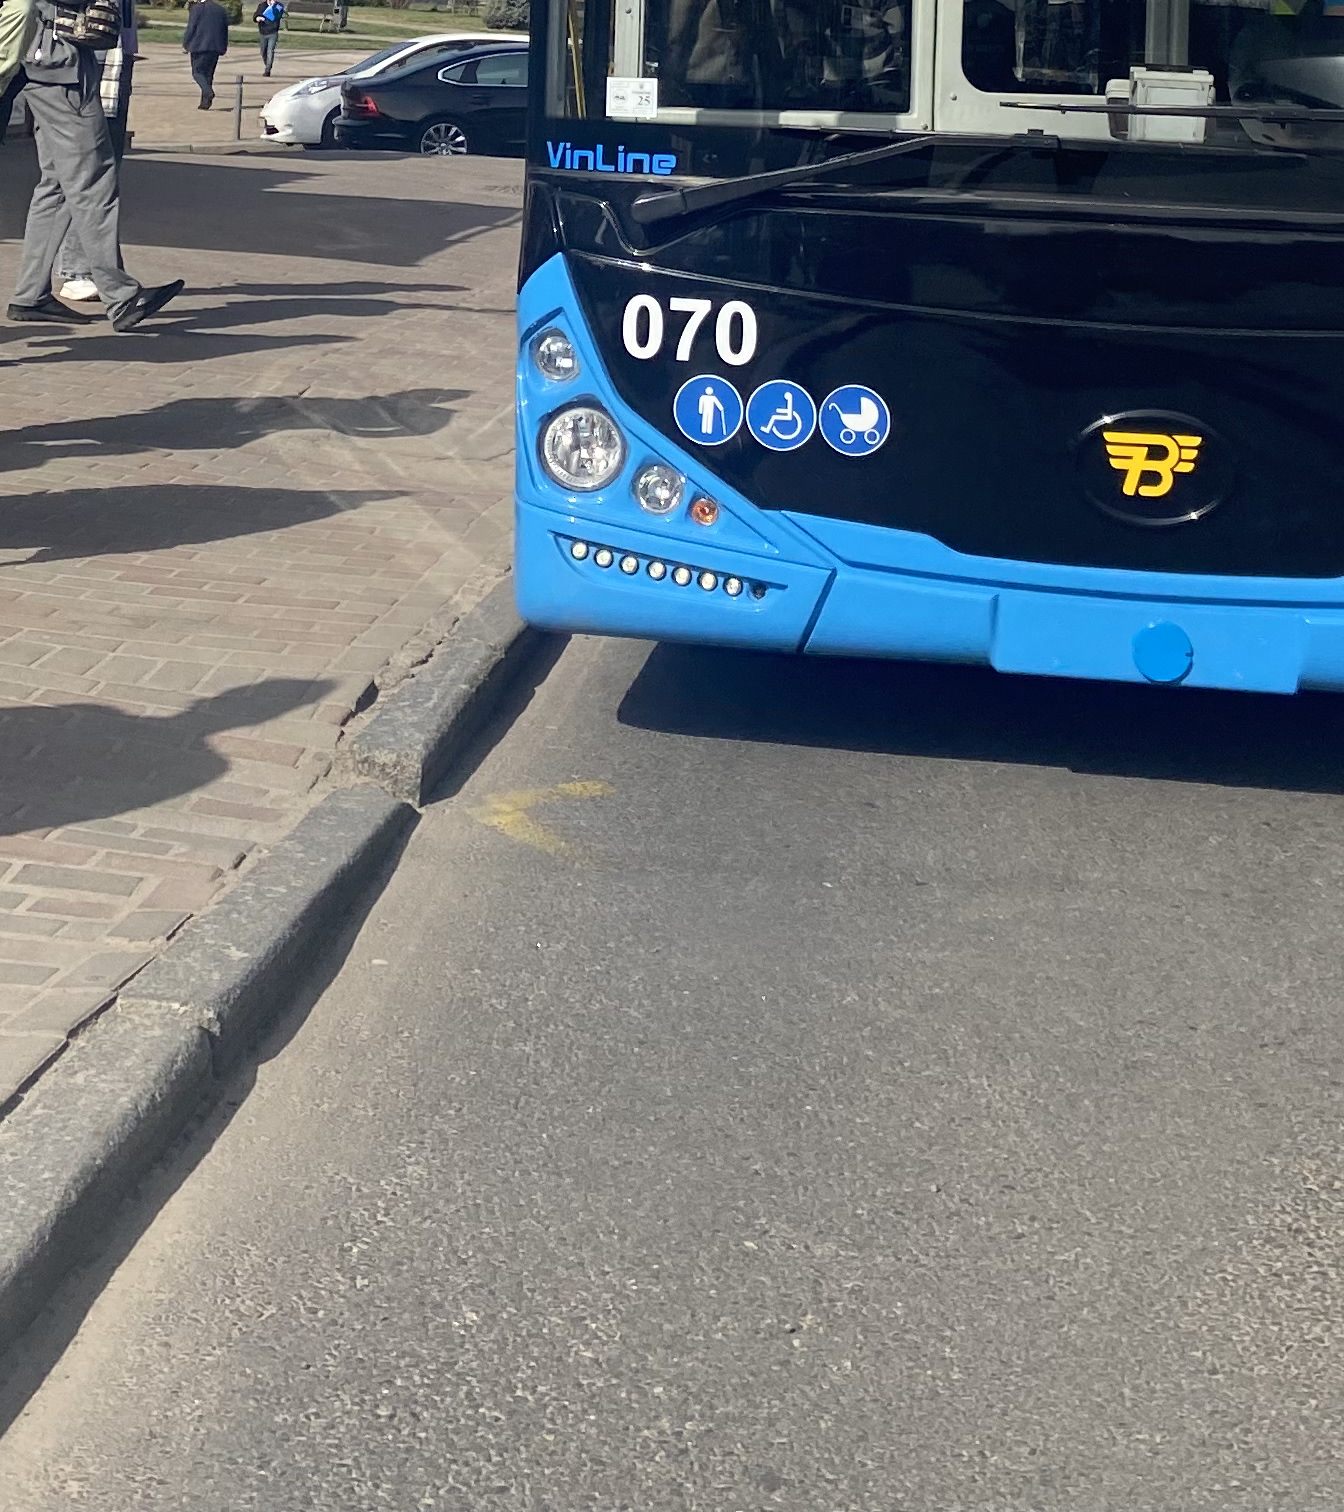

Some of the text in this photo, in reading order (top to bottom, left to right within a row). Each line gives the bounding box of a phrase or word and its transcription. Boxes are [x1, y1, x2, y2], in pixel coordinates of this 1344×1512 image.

[638, 95, 651, 106] 25
[547, 141, 677, 175] VinLine
[622, 294, 758, 366] 070
